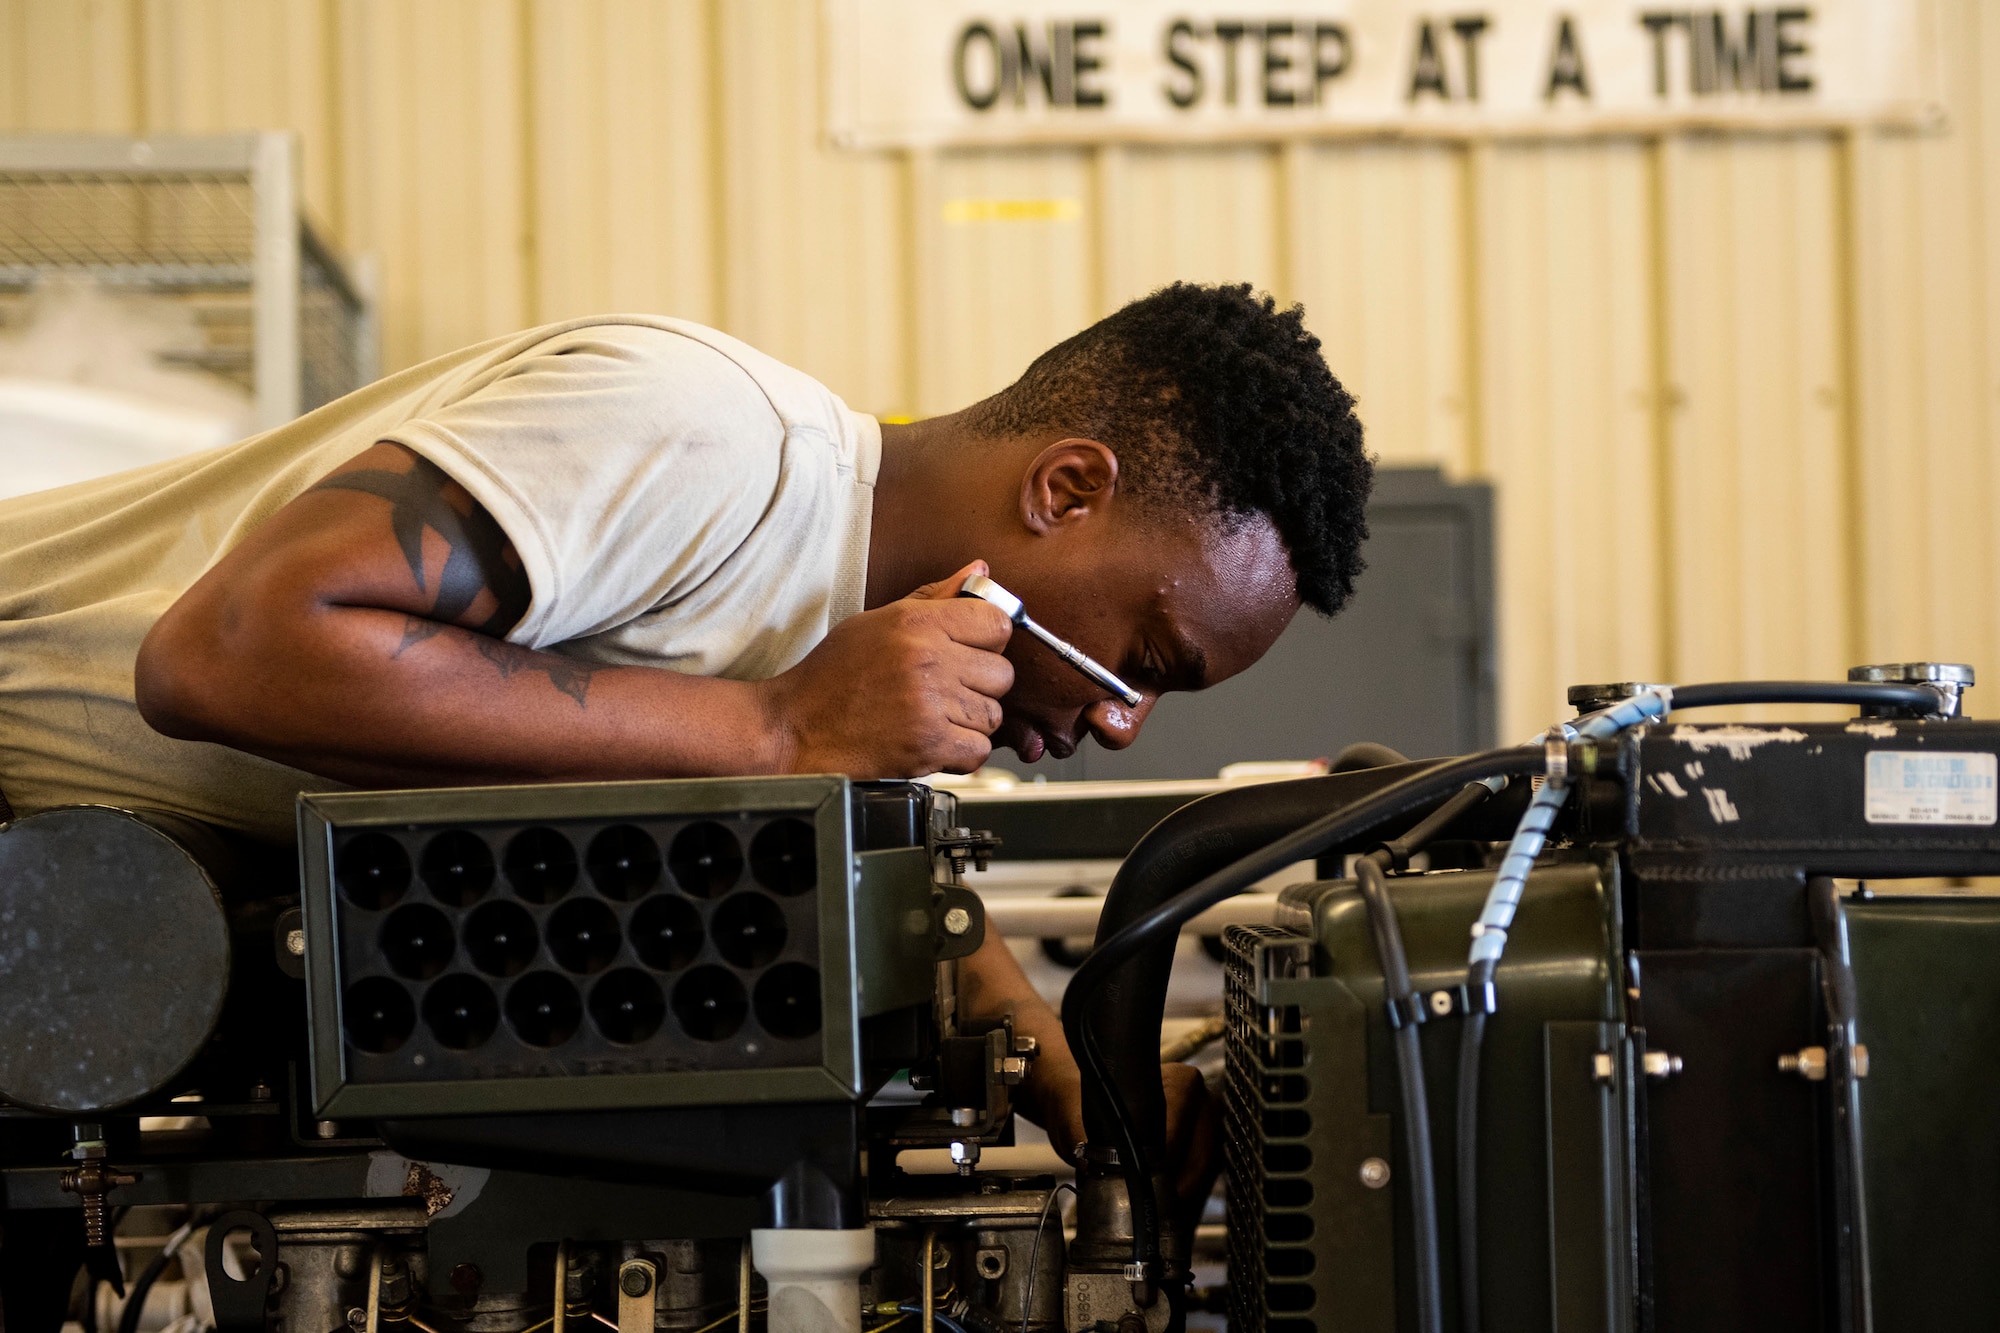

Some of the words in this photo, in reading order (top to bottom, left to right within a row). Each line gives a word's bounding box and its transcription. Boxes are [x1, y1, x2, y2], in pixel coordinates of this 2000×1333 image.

[953, 20, 1108, 110] ONE
[1162, 19, 1353, 109] STEP
[1406, 16, 1489, 104] AT
[1542, 15, 1592, 104] A
[1640, 9, 1813, 97] TIME
